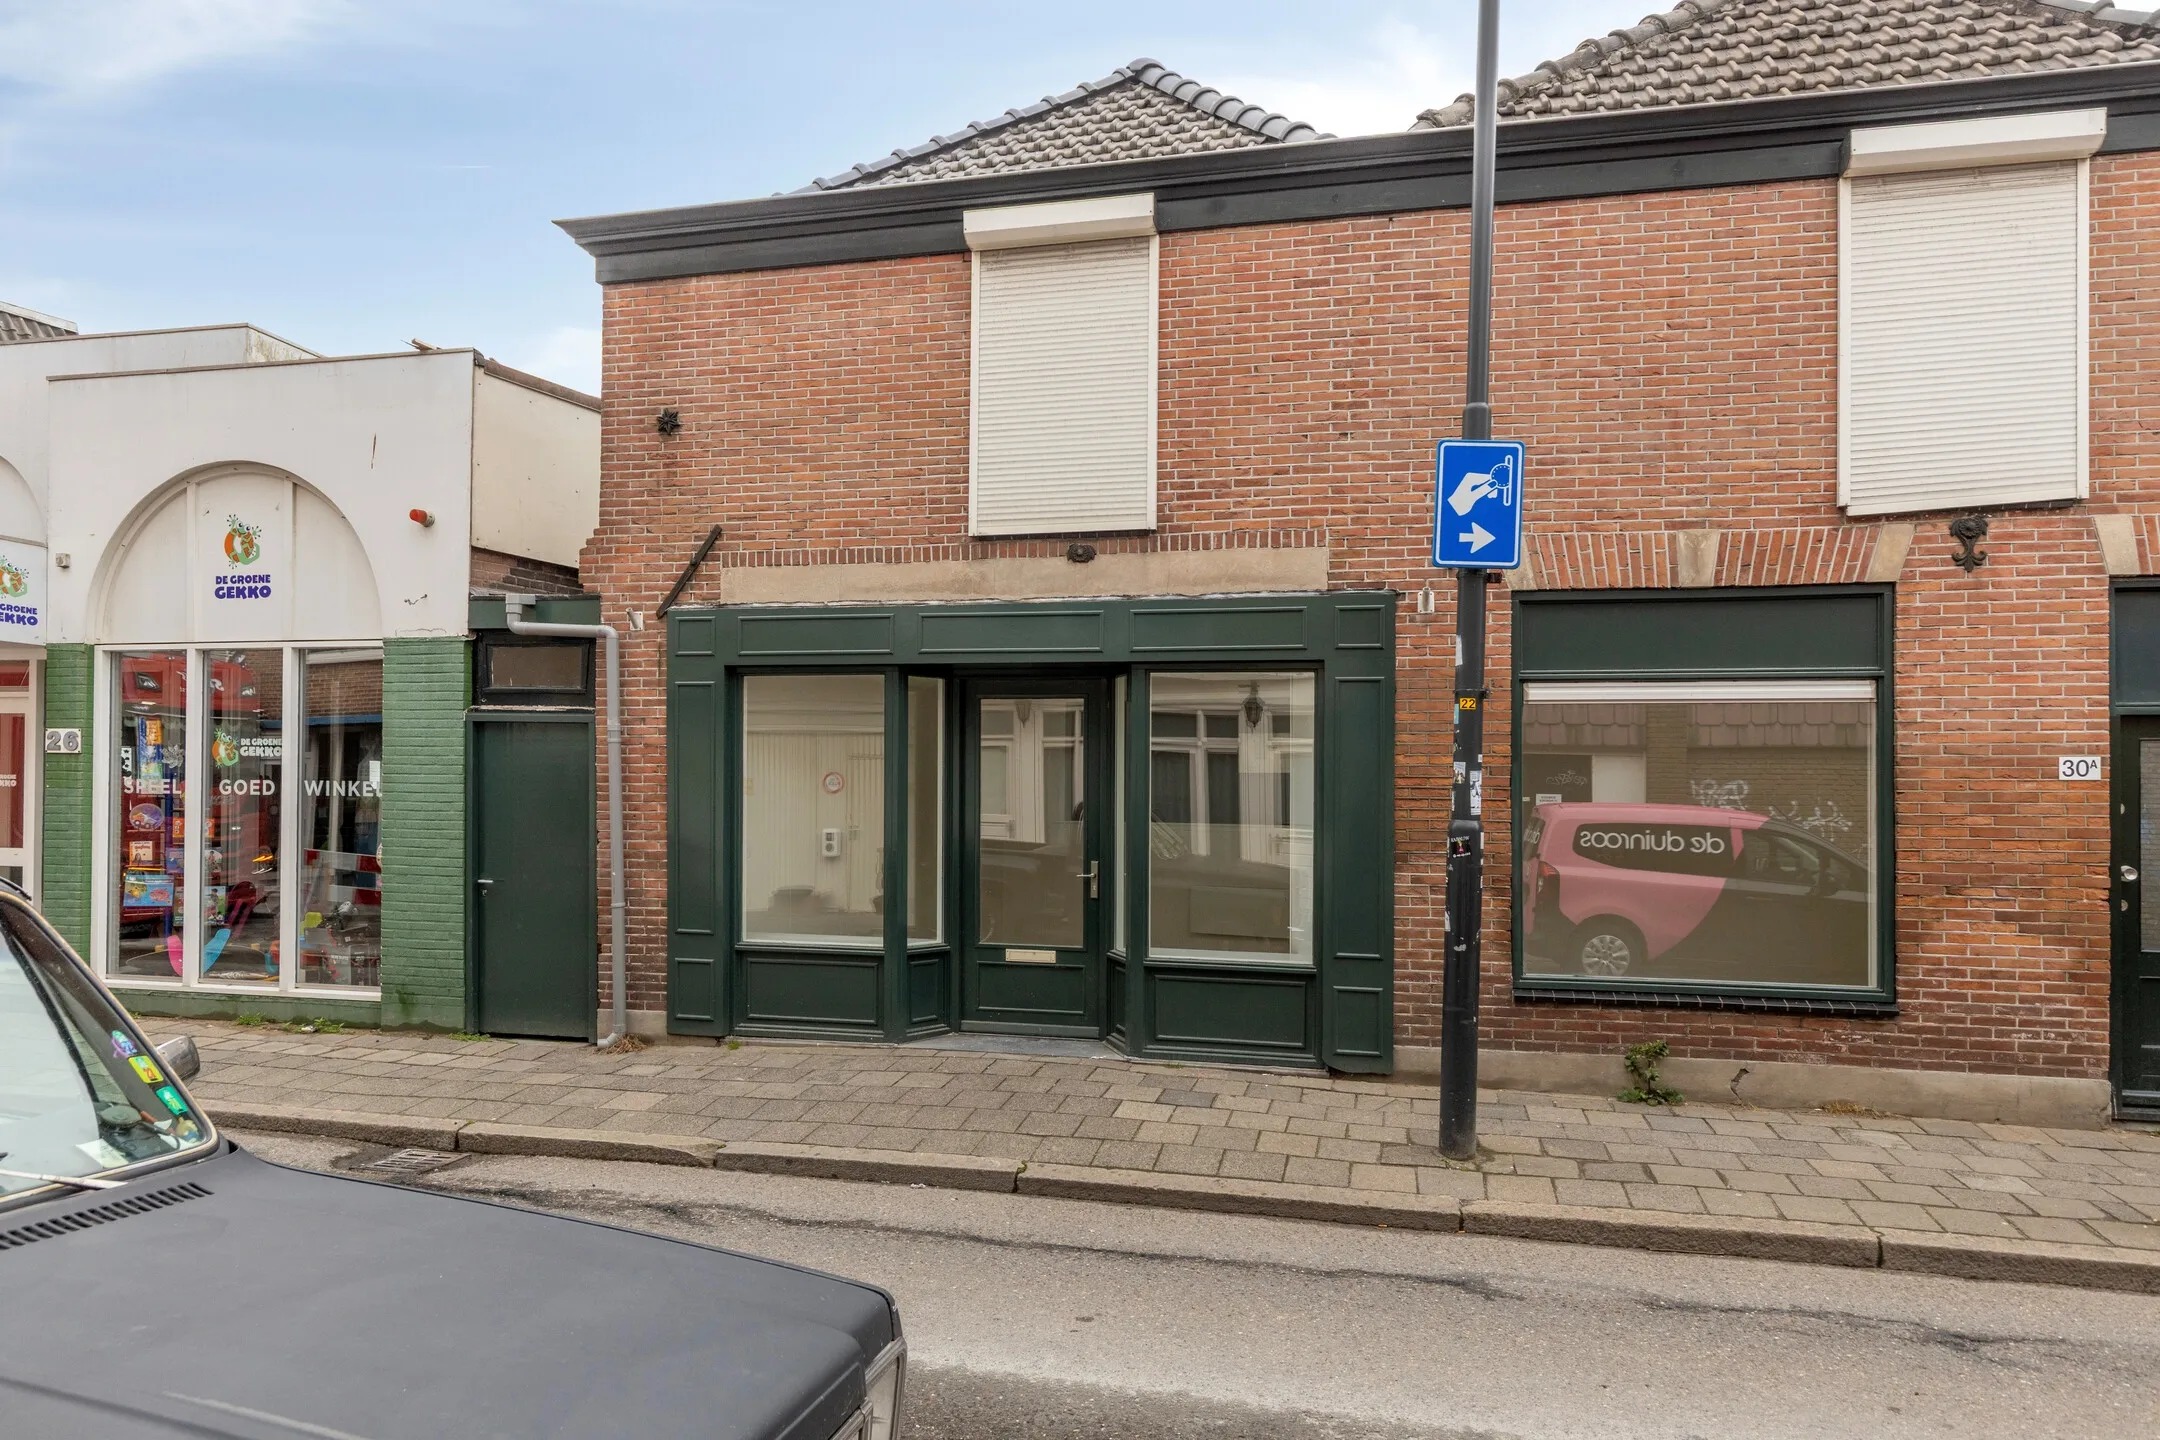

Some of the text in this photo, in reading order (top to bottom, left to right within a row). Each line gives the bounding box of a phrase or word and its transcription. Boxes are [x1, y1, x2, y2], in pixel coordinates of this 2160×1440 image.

[215, 574, 271, 585] DE GROENE
[214, 585, 272, 599] GEKKO
[1461, 698, 1476, 709] 22
[46, 730, 79, 752] 26
[240, 738, 251, 746] DE
[240, 746, 282, 757] GEKKO
[123, 777, 182, 795] SPEEL
[219, 779, 275, 796] GOED
